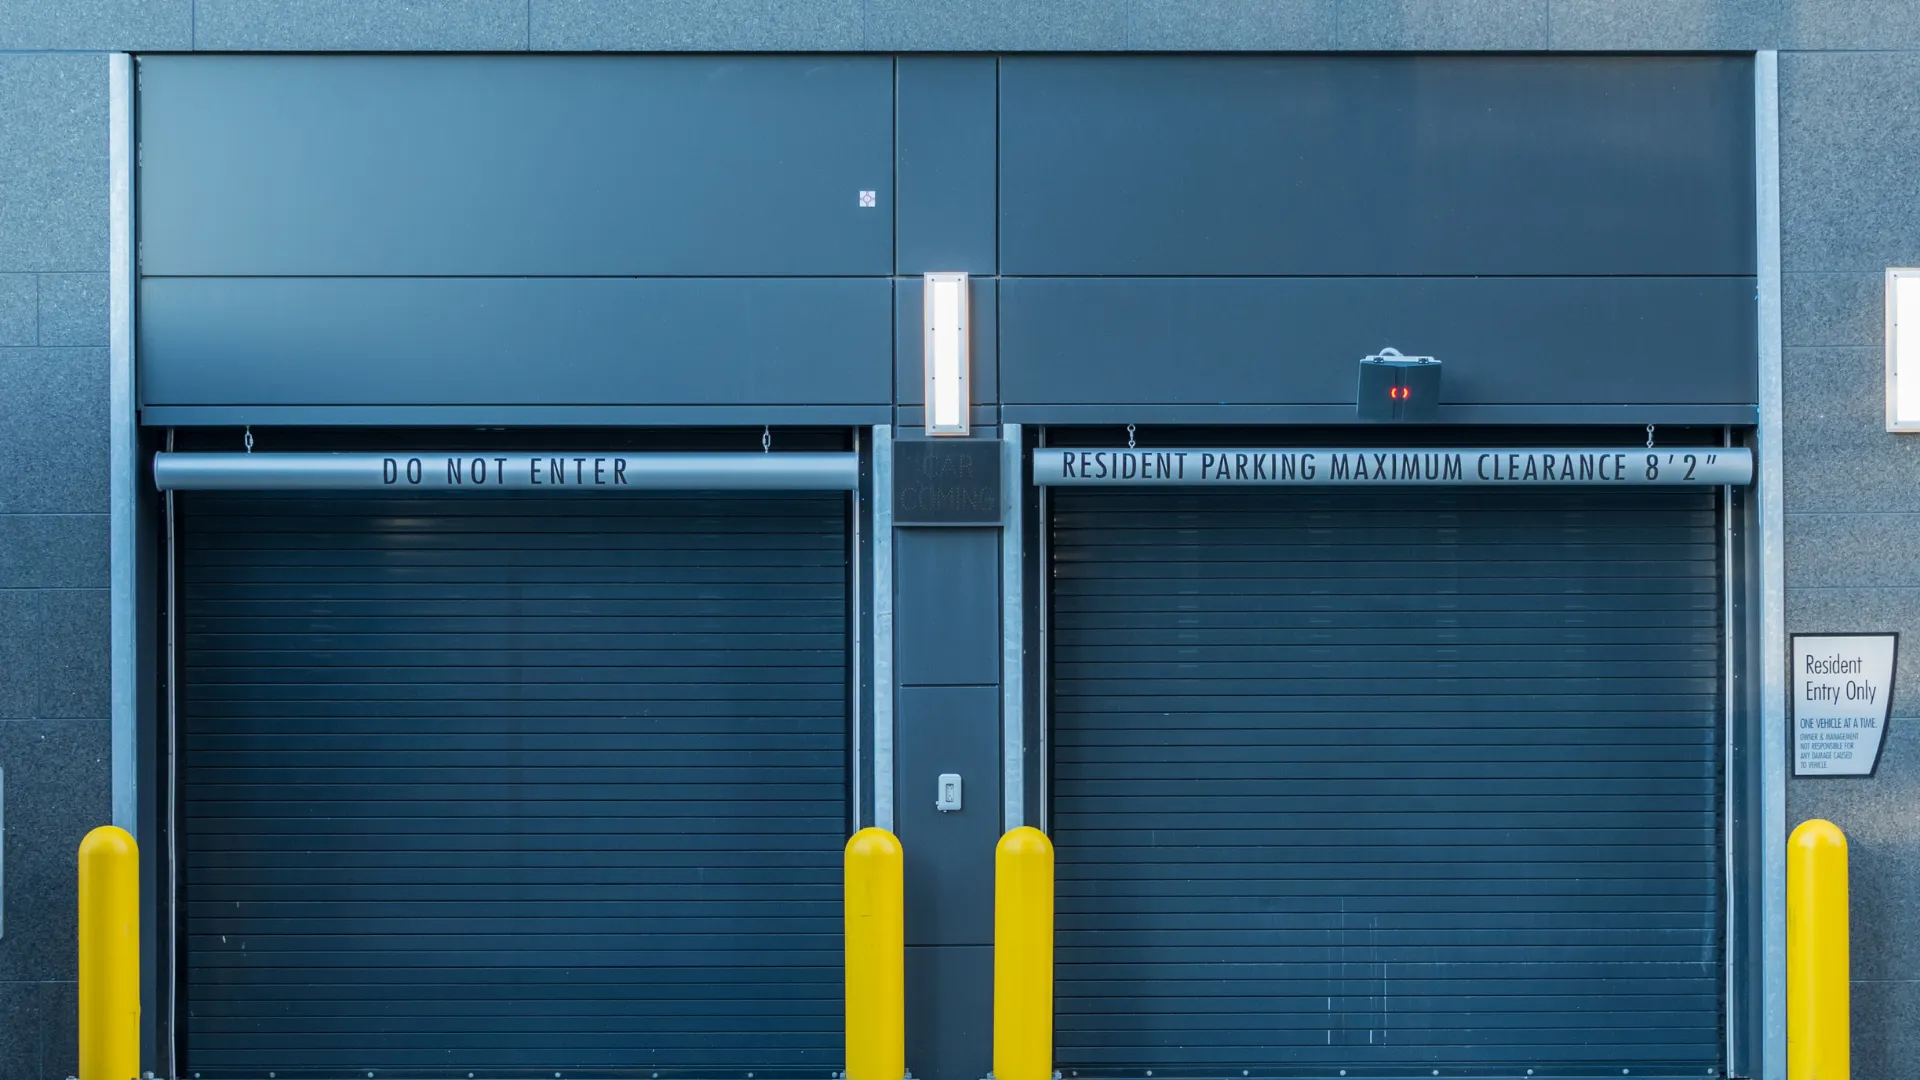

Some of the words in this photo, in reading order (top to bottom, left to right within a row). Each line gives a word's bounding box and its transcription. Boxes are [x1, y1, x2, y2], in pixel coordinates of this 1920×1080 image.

[383, 458, 422, 485] DO
[447, 458, 507, 485] NOT
[530, 458, 628, 485] ENTER
[922, 454, 973, 479] CAR
[1062, 451, 1188, 479] RESIDENT
[1201, 453, 1316, 480] PARKING
[1330, 453, 1463, 480] MAXIMUM
[1477, 453, 1626, 480] CLEARANCE
[901, 486, 994, 511] COMING
[1806, 653, 1863, 675] Resident
[1806, 680, 1840, 705] Entry
[1846, 679, 1877, 705] Only
[1800, 718, 1814, 729] ONE
[1816, 717, 1842, 729] VEHICLE
[1843, 717, 1852, 729] AT
[1853, 717, 1859, 729] A
[1800, 733, 1818, 741] OWNER
[1825, 732, 1859, 741] MANAGEMENT
[1800, 742, 1810, 750] NOT
[1811, 742, 1842, 750] RESPONSIBLE
[1844, 742, 1854, 750] FOR
[1800, 751, 1810, 760] ANY
[1811, 751, 1832, 760] DAMAGE
[1833, 751, 1853, 760] CAUSED
[1800, 761, 1807, 769] TO
